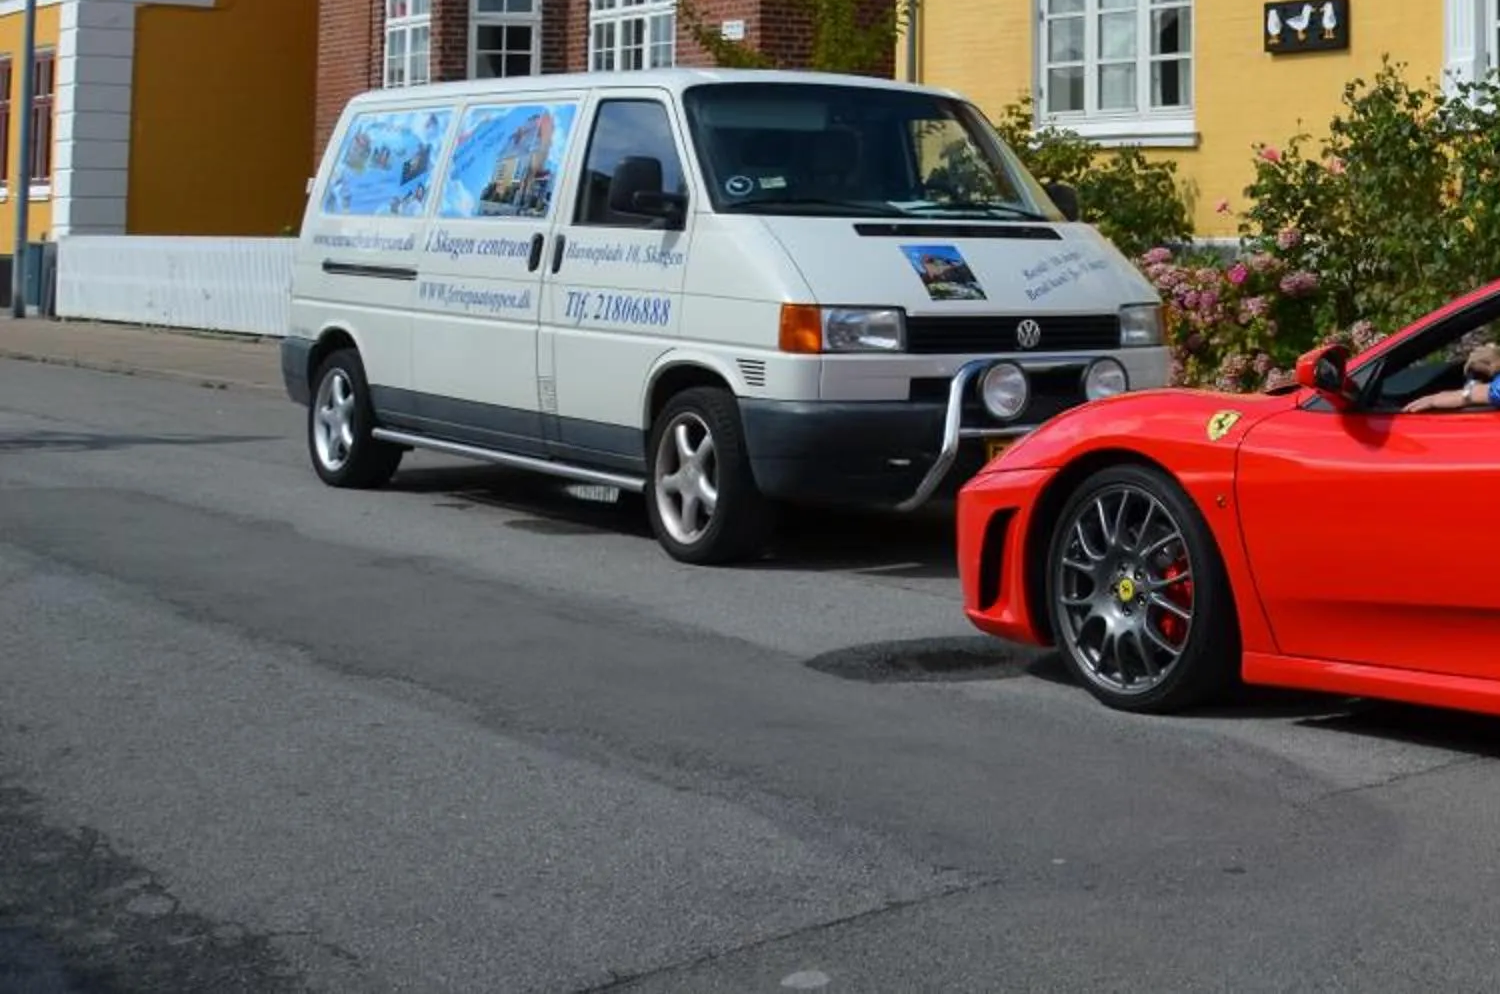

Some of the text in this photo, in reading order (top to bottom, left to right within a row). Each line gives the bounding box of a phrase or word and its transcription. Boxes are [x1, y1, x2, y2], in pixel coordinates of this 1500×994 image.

[431, 229, 475, 260] Skagen
[477, 238, 530, 257] centrum
[593, 293, 671, 326] 21806888
